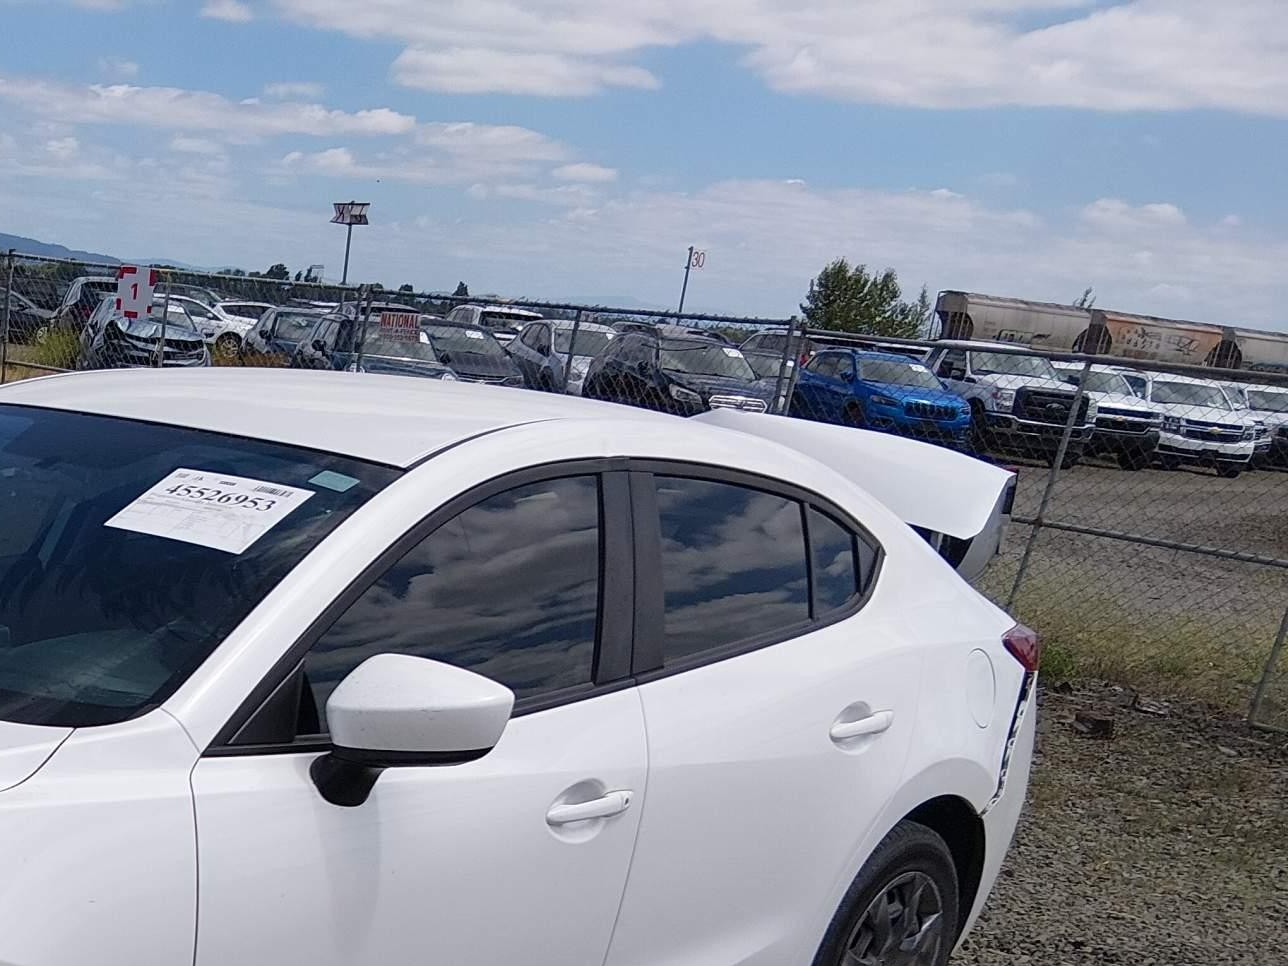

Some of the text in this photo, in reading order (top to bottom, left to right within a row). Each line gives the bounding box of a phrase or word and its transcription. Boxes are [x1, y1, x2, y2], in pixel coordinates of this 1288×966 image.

[691, 250, 706, 268] 30
[130, 282, 139, 301] 1
[380, 312, 421, 329] NATIONAL
[165, 483, 278, 513] 45526953
